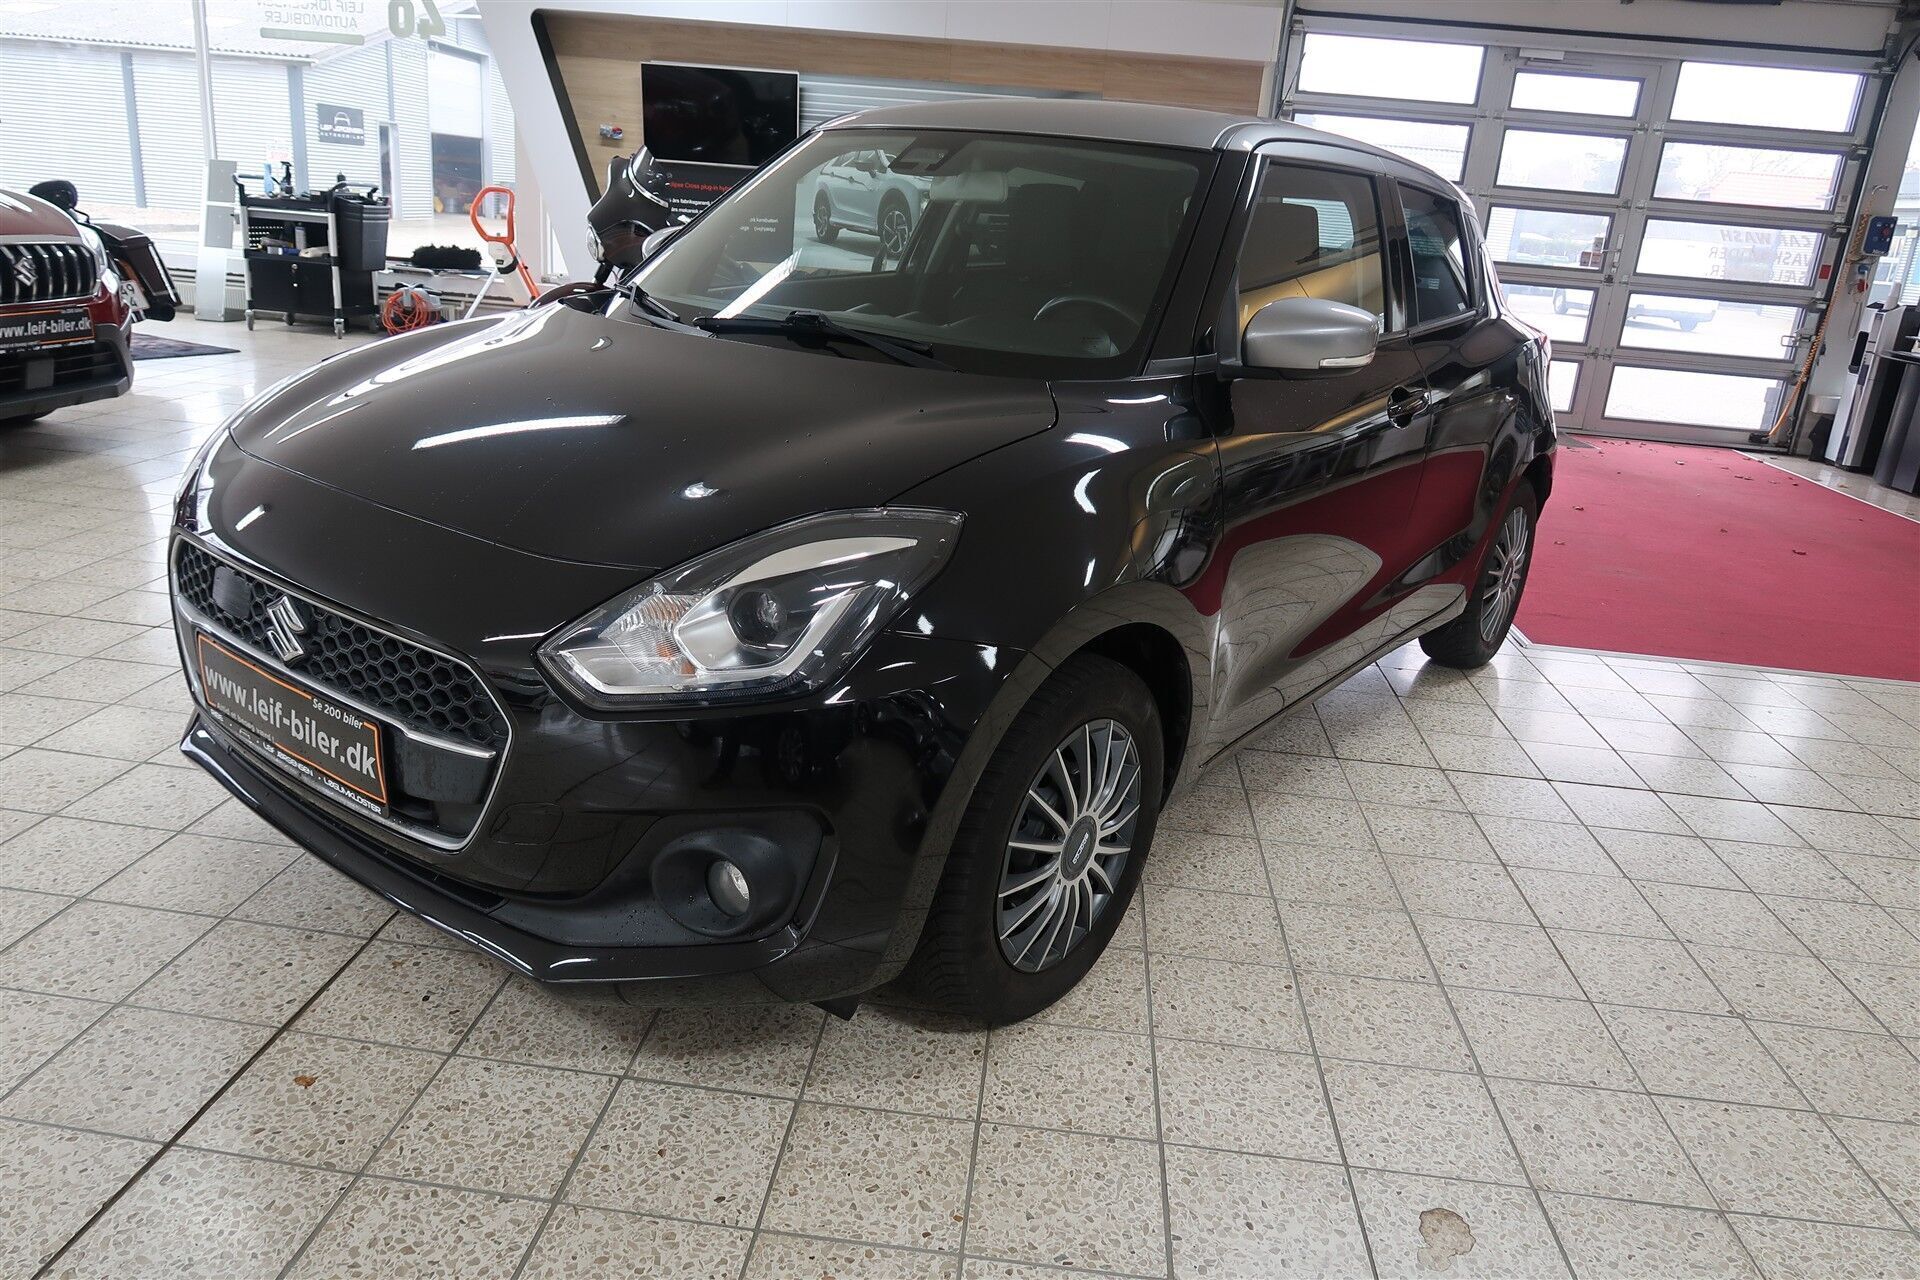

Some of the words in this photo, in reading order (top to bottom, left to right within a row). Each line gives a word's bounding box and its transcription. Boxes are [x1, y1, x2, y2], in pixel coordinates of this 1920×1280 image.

[204, 665, 377, 779] www.leif-biler.dk
[312, 698, 323, 711] Se
[324, 703, 341, 720] 200
[342, 710, 364, 730] biler
